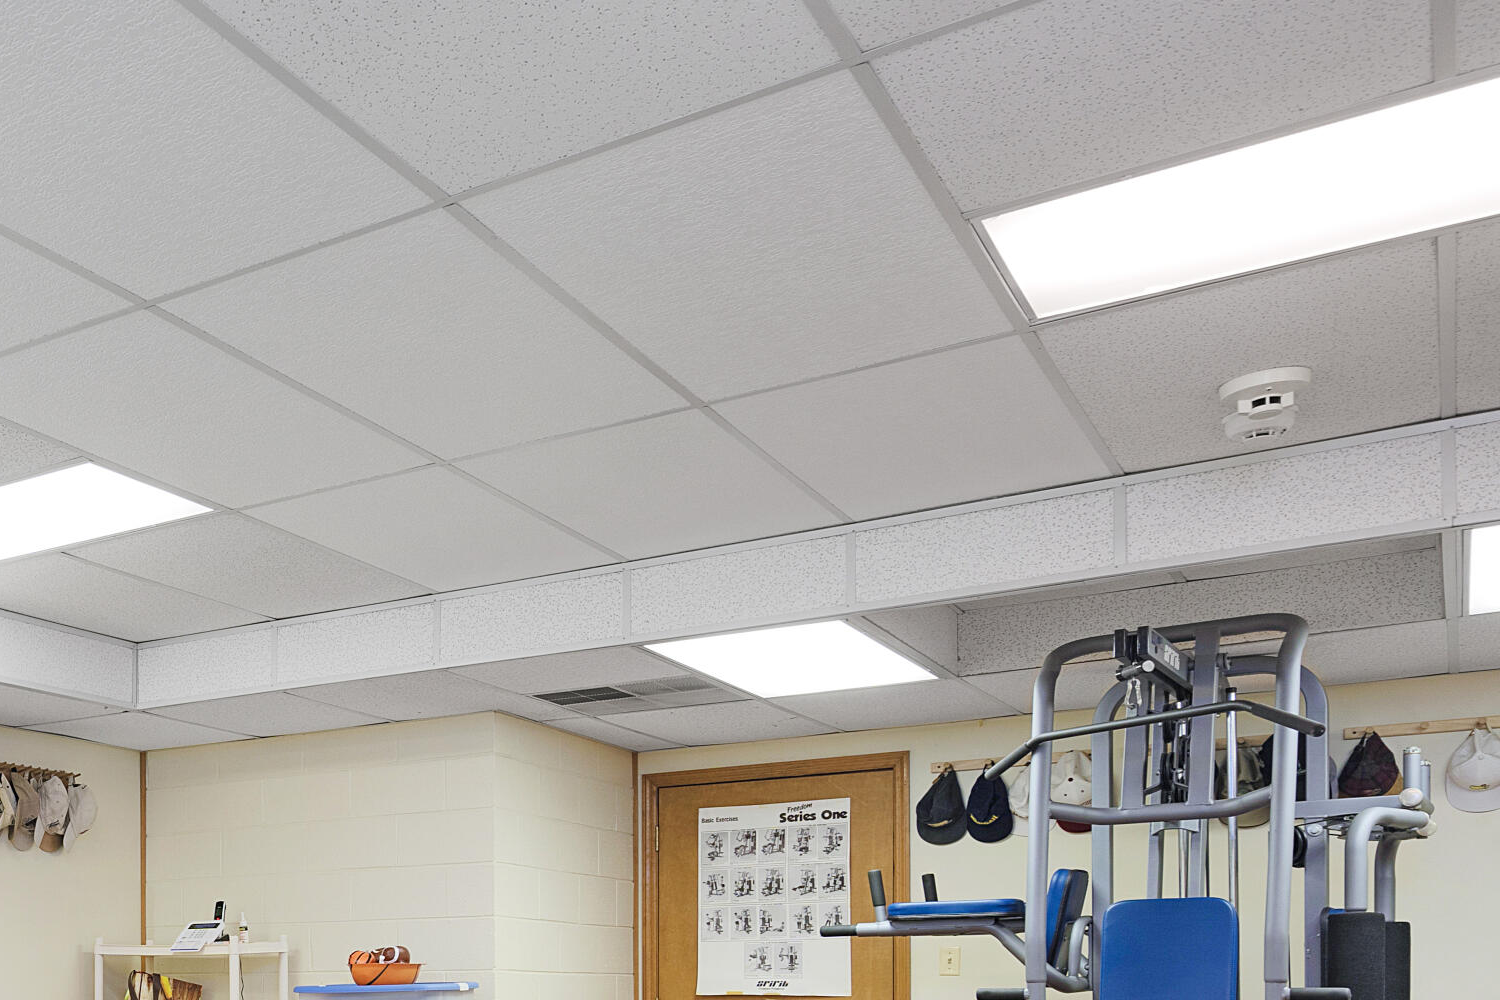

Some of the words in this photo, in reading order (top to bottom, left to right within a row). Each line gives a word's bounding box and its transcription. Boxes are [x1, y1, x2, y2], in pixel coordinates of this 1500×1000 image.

[787, 802, 813, 813] Freedom
[779, 811, 817, 823] Series
[821, 809, 848, 820] One
